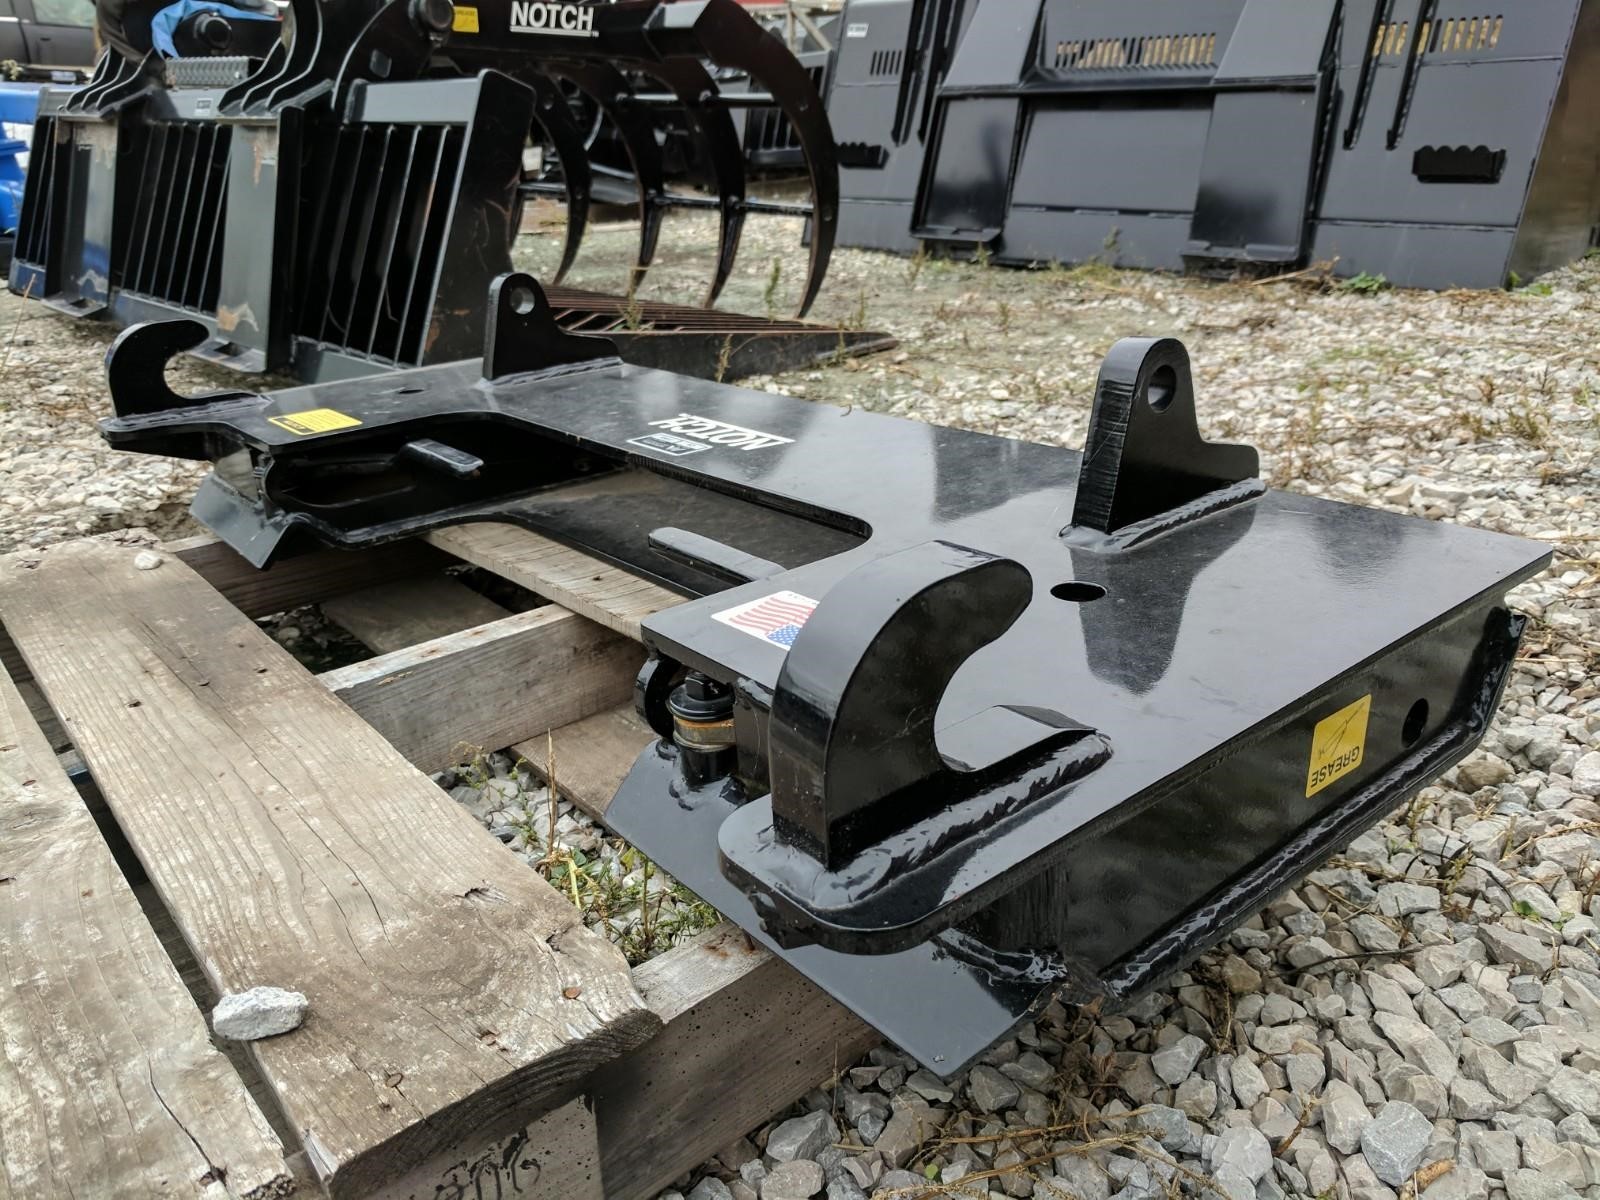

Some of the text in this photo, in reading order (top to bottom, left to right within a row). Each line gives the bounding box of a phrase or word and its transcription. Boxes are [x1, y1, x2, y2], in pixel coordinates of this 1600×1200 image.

[510, 1, 594, 31] NOTCH
[648, 416, 786, 450] NOTCH
[1310, 746, 1360, 788] GREASE
